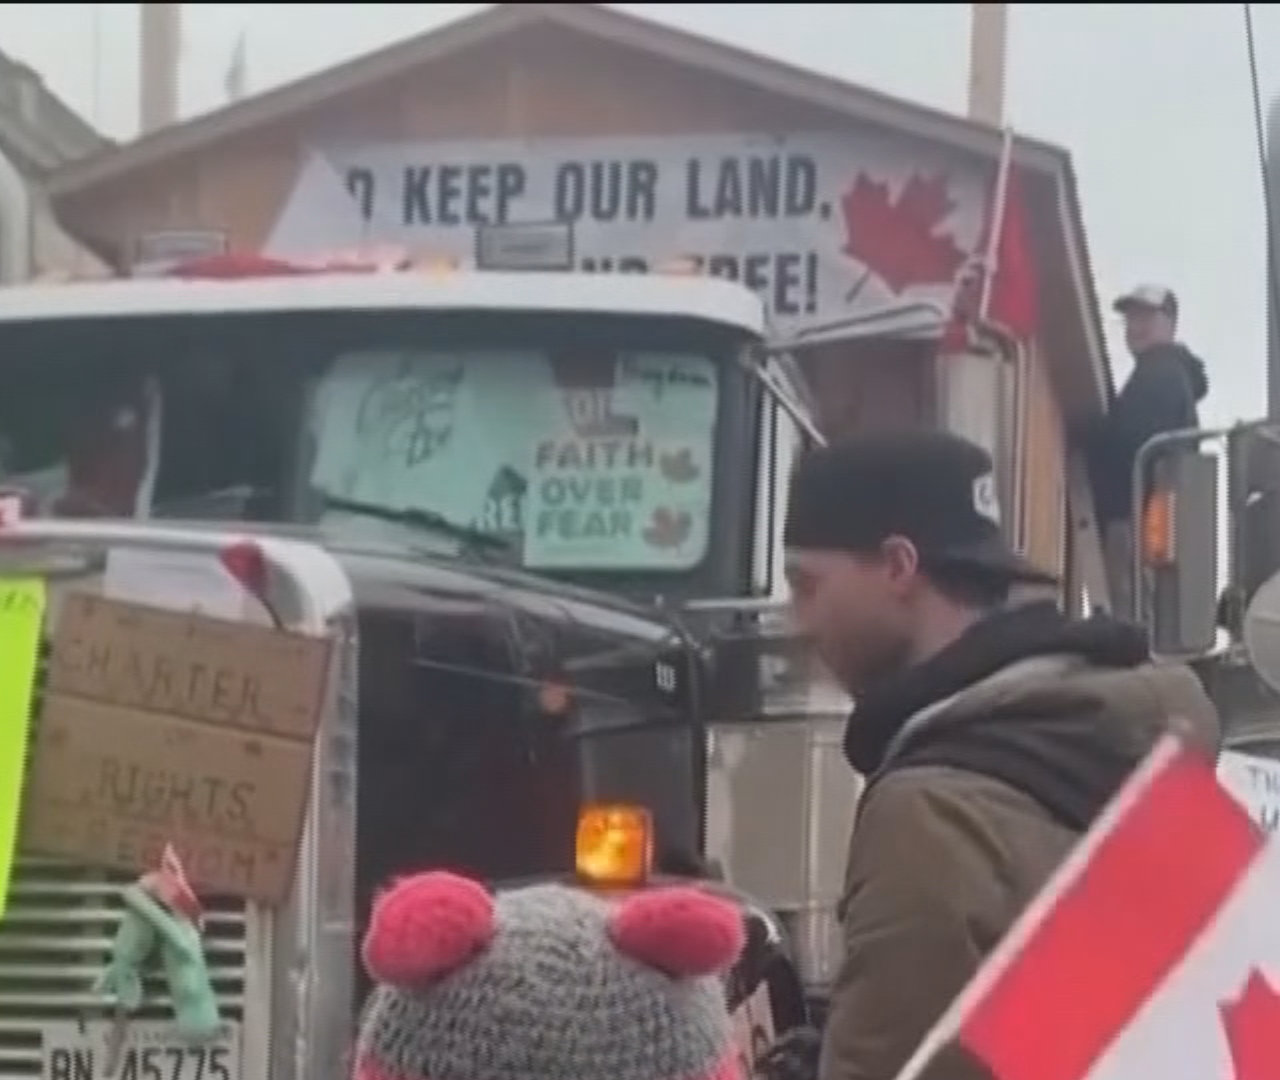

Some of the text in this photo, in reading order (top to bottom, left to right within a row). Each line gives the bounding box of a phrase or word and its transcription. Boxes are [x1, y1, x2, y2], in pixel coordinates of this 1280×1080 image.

[403, 163, 526, 226] KEEP
[556, 160, 657, 222] OUR
[685, 154, 831, 220] LAND.
[535, 439, 655, 470] FAITH
[541, 477, 643, 507] OVER
[536, 509, 633, 540] FEAR
[97, 755, 257, 824] RIGHTS
